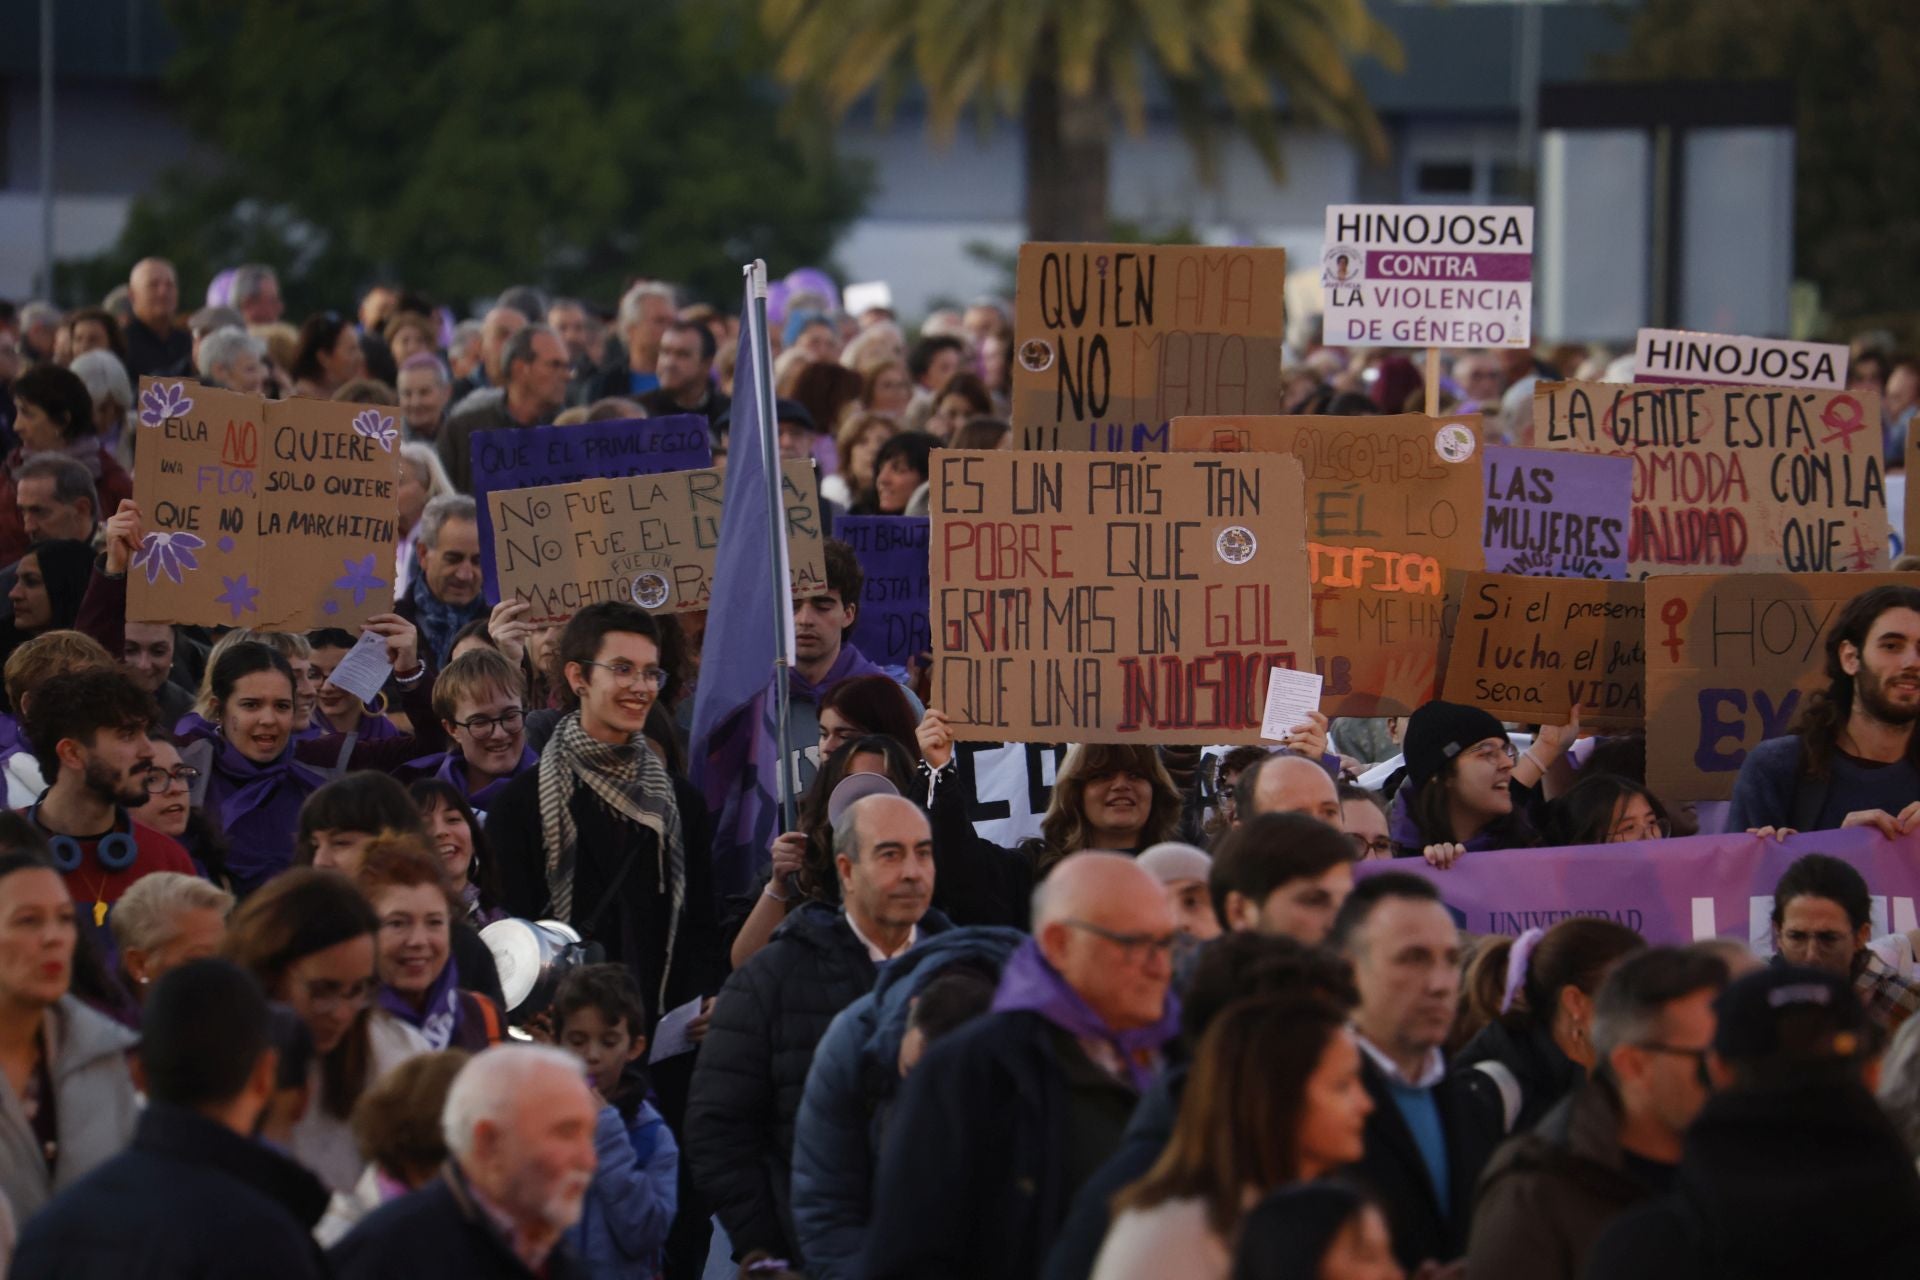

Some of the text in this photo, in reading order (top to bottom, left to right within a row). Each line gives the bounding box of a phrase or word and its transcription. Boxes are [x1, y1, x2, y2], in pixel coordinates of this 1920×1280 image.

[1338, 214, 1523, 245] HINOJOSA
[1378, 255, 1478, 277] CONTRA
[1176, 254, 1253, 325] AMA
[1332, 287, 1522, 310] LA VIOLENCIA
[1348, 316, 1504, 343] DE GÉNERO
[1057, 330, 1247, 422] NO MATA
[1646, 339, 1836, 382] HINOJOSA
[1548, 388, 1816, 450] LA GENTE ESTÁ
[164, 417, 376, 465] ELLA NO QUIERE
[480, 443, 529, 474] QUE
[549, 442, 574, 466] EL
[1292, 427, 1449, 484] ALCOHOL
[265, 471, 315, 492] SOLO
[324, 476, 393, 499] QUIERE
[628, 483, 669, 511] LA
[942, 457, 1260, 518] ES UN PAÍS TAN
[1487, 461, 1555, 504] LAS
[1770, 452, 1833, 507] CON
[1844, 454, 1886, 509] LA
[155, 501, 394, 543] QUE NO LA MARCHITEN
[1315, 483, 1458, 539] ÉL LO
[1484, 506, 1623, 559] MUJERES
[639, 518, 681, 552] EL
[842, 525, 870, 552] MI
[944, 521, 1074, 582] POBRE
[1107, 522, 1200, 582] QUE
[1782, 517, 1847, 573] QUE
[611, 555, 673, 575] FUE UN
[940, 588, 1032, 653] GRITA
[1043, 586, 1115, 653] MAS
[1138, 587, 1181, 654] UN
[1205, 584, 1287, 648] GOL
[1358, 598, 1397, 647] ME
[1473, 583, 1512, 620] Si
[1526, 591, 1550, 622] el
[1713, 596, 1837, 667] HOY
[1574, 638, 1598, 671] el
[942, 657, 1014, 728] QUE
[1030, 657, 1101, 728] UNA
[1568, 679, 1642, 710] VIDA
